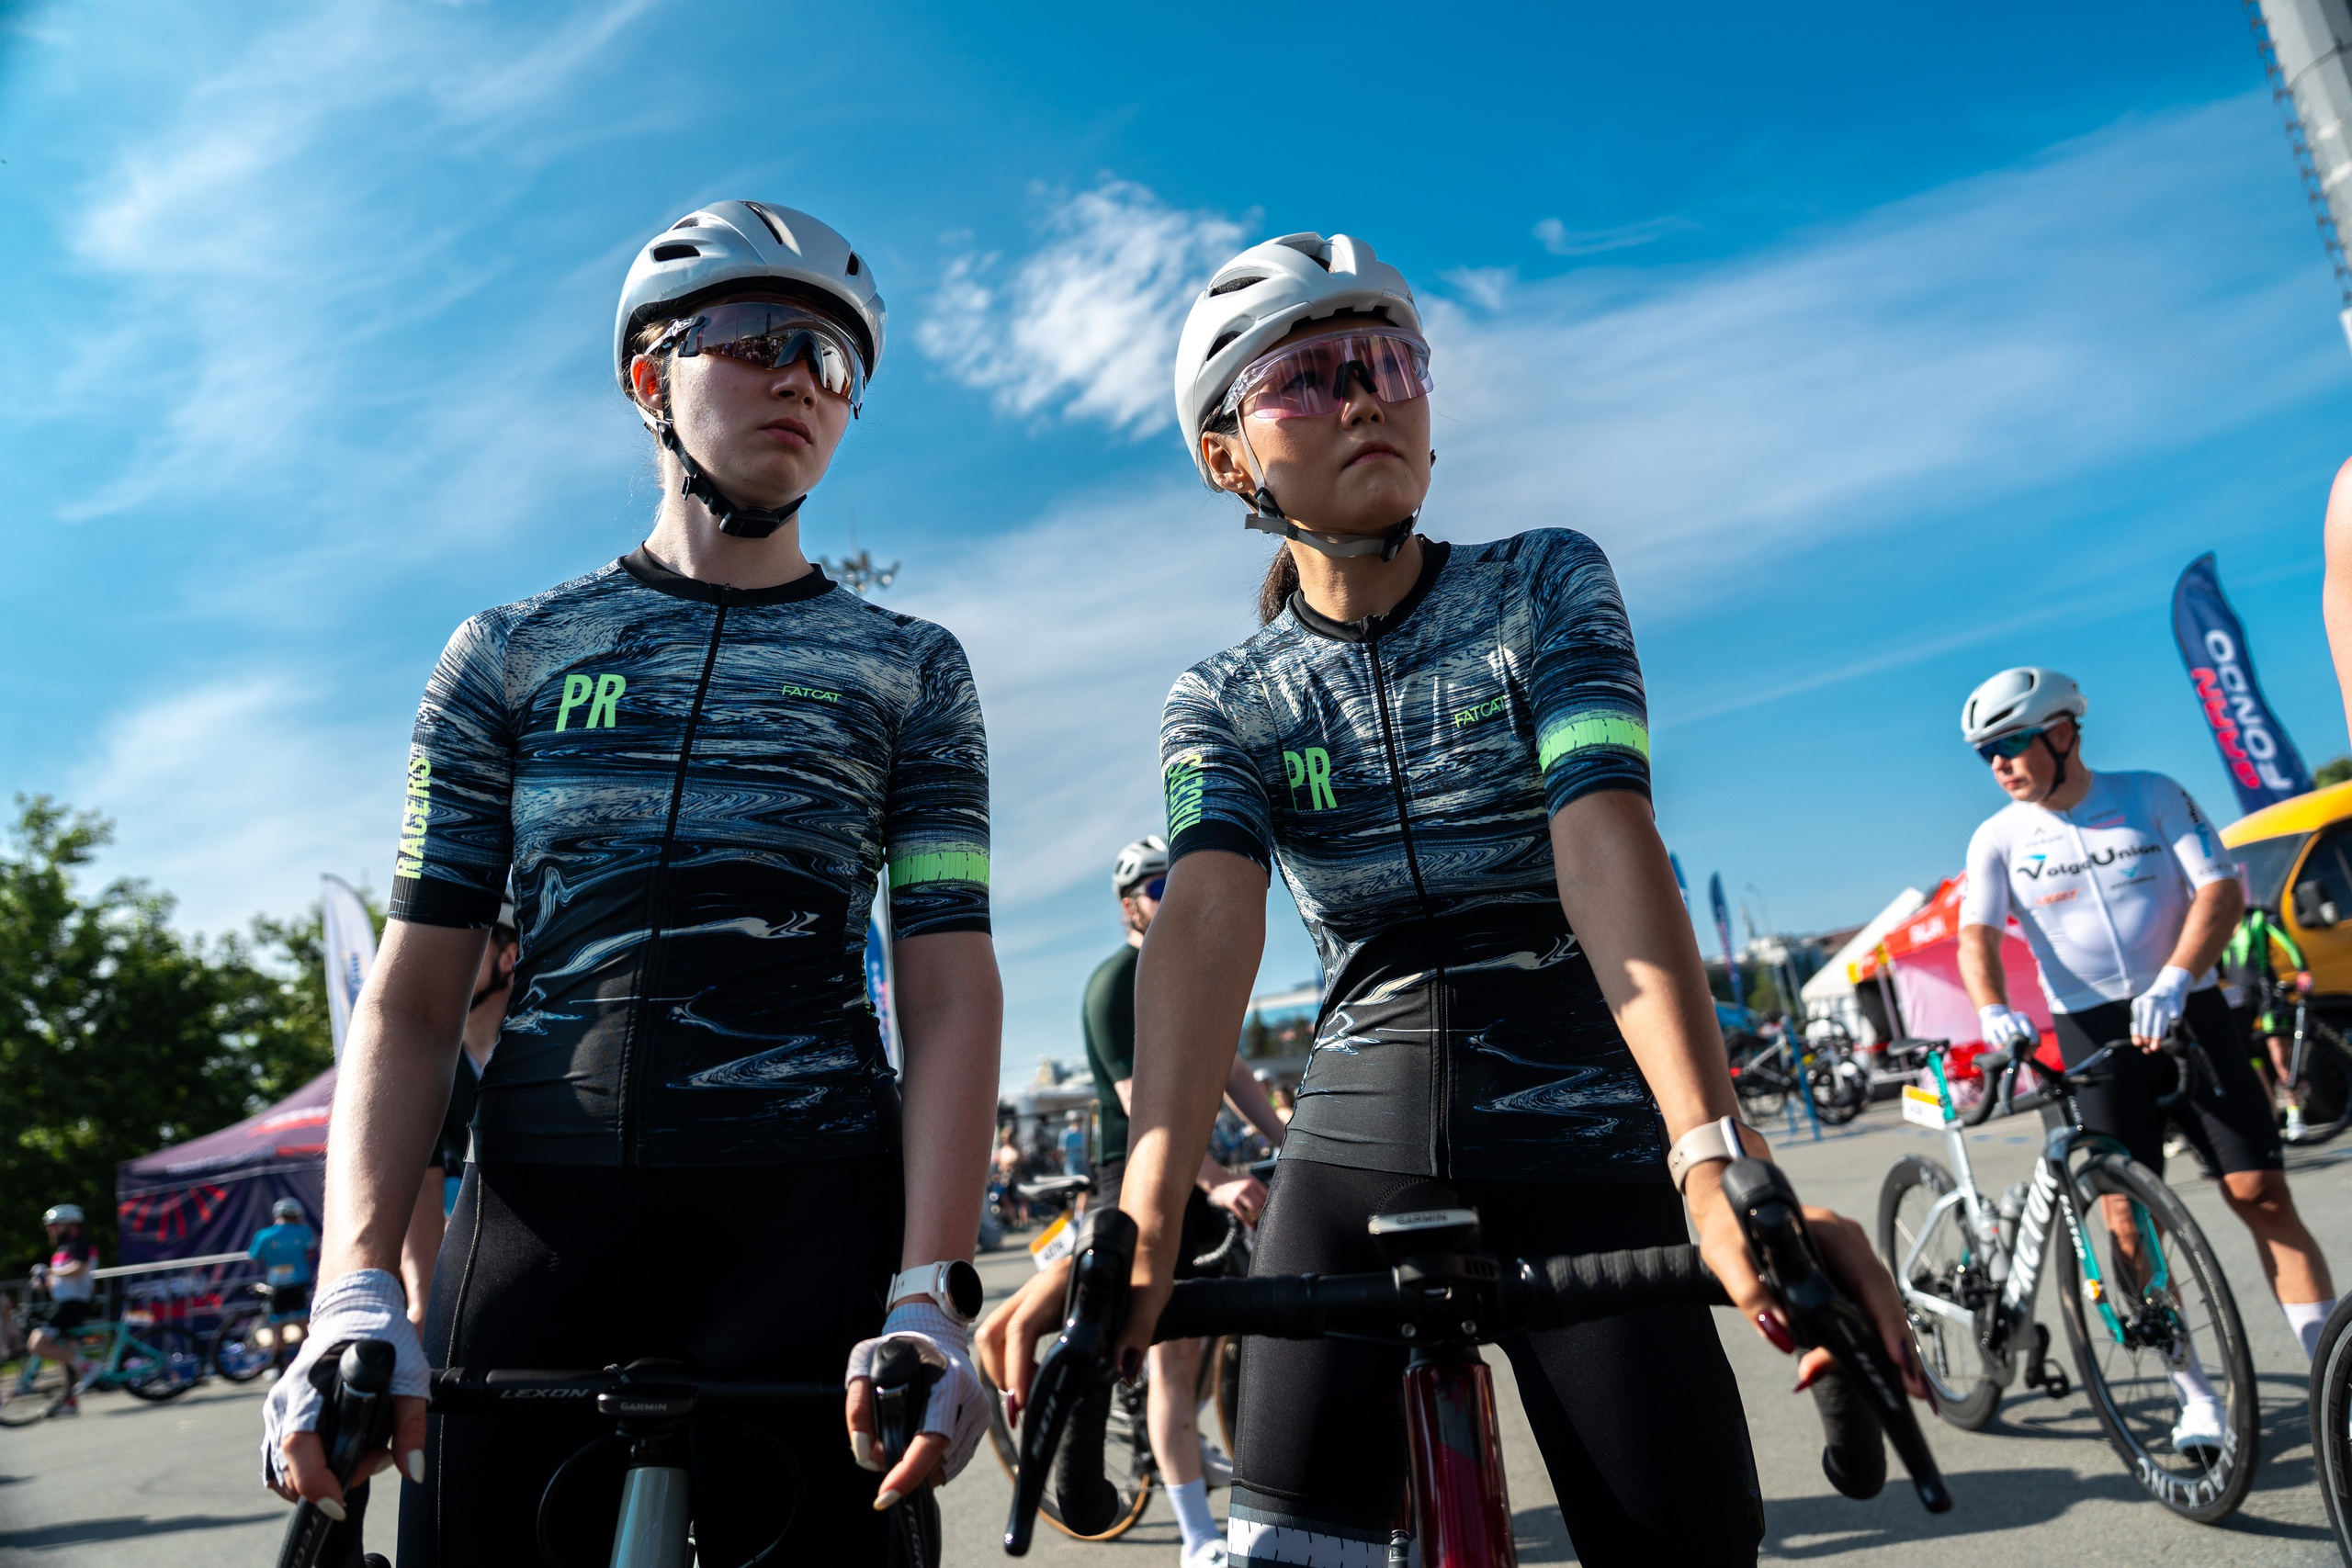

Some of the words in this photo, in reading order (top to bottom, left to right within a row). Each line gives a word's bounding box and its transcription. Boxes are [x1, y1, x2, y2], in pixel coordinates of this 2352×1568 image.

[555, 673, 627, 733] PR
[781, 684, 842, 704] FATCAT
[1453, 695, 1507, 728] FATCAT
[2206, 628, 2293, 791] FONDO
[2190, 668, 2260, 789] GRAN
[1168, 753, 1204, 846] RACERS
[1283, 746, 1339, 813] PR
[395, 757, 432, 879] RACERS
[1396, 1212, 1449, 1225] GARMIN
[2001, 1155, 2059, 1310] FACTOR
[2059, 1193, 2086, 1261] FACTOR
[500, 1387, 591, 1399] LEXON
[619, 1401, 668, 1413] GARMIN
[2136, 1457, 2177, 1505] INC
[2183, 1425, 2239, 1509] BLACK
